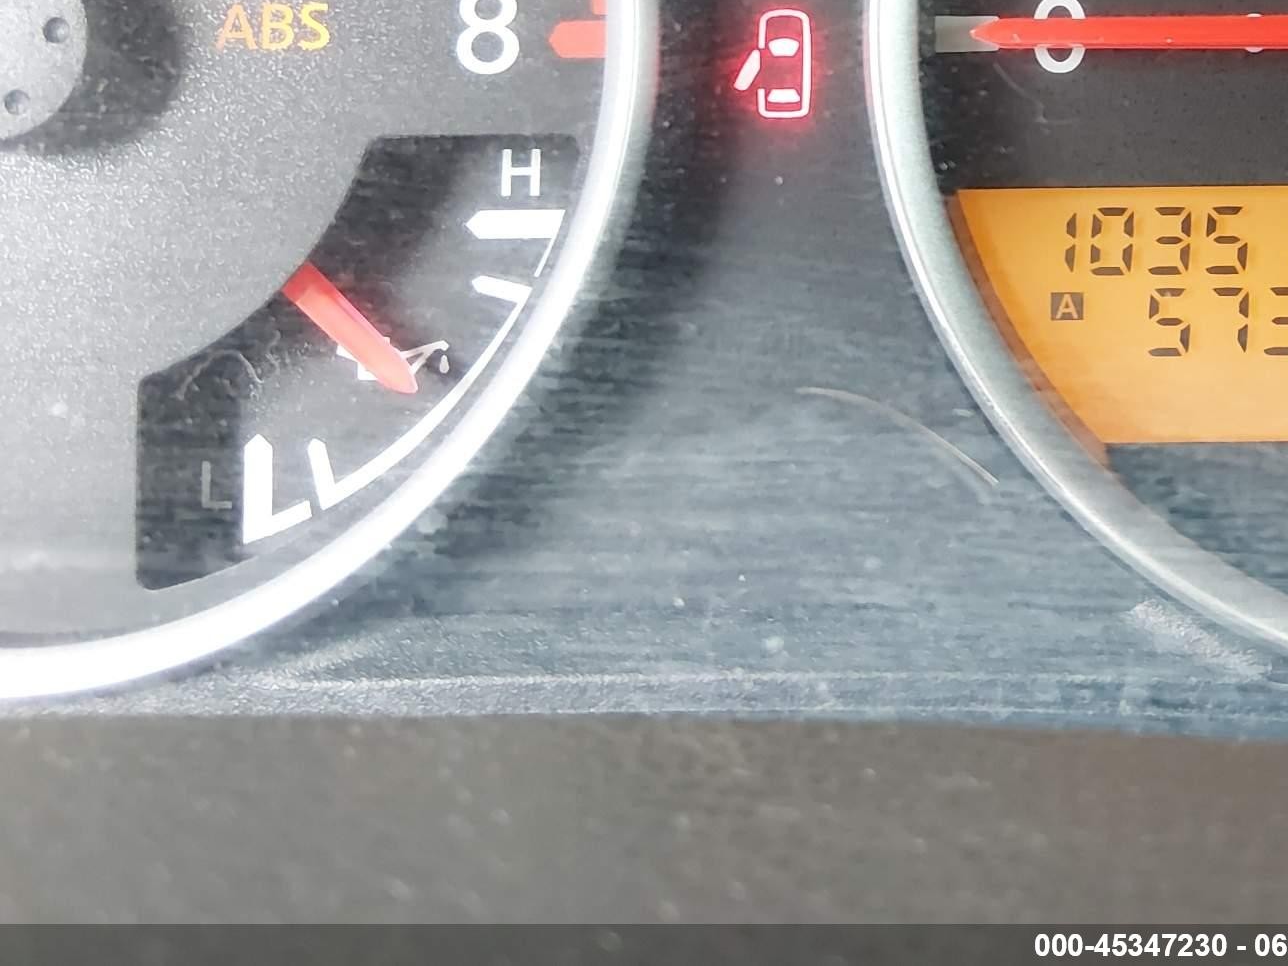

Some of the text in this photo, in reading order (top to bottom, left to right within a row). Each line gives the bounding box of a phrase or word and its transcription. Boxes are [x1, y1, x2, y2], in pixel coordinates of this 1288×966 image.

[215, 1, 331, 52] ABS
[501, 149, 542, 197] H
[1056, 294, 1079, 319] A
[201, 462, 233, 509] L
